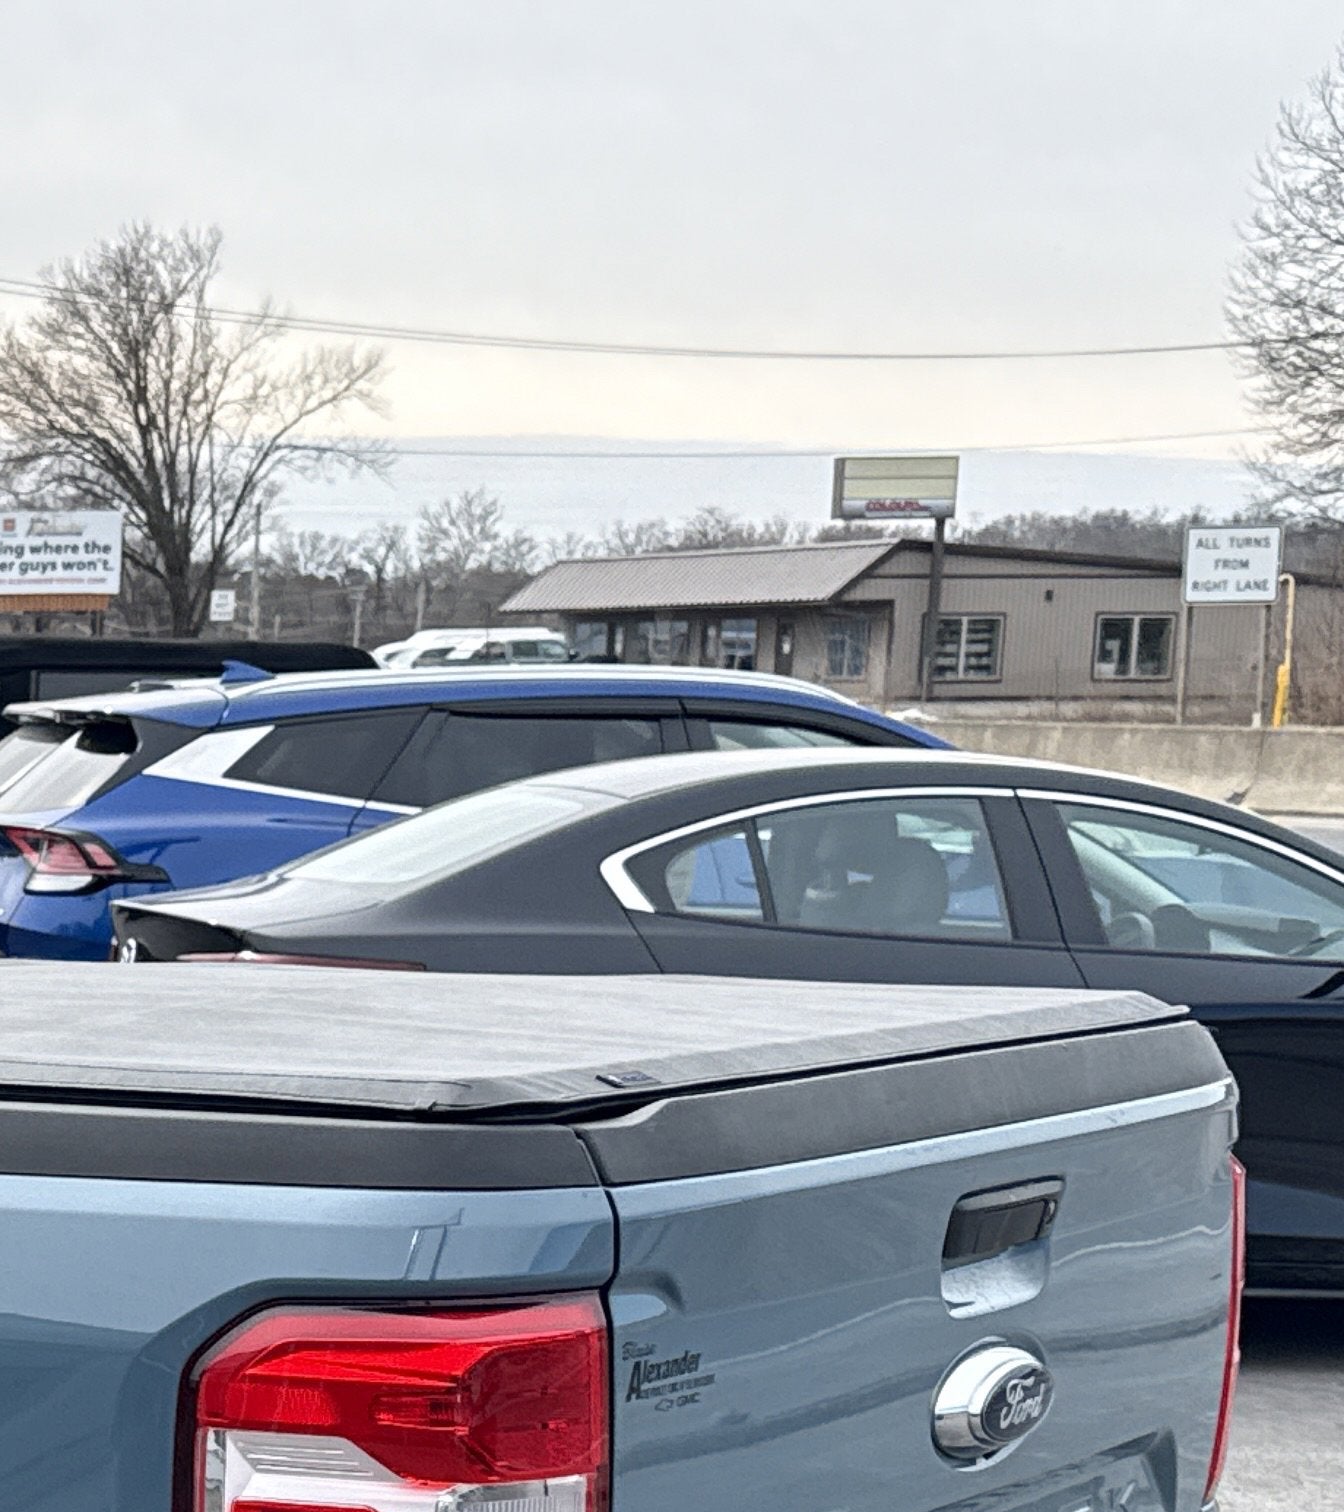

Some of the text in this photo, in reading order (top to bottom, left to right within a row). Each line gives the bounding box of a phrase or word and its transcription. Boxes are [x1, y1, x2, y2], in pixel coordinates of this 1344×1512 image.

[29, 540, 80, 555] where
[83, 540, 112, 554] the
[1195, 536, 1272, 550] ALL TURNS
[18, 560, 58, 576] guys
[62, 558, 114, 572] won't.
[1214, 558, 1250, 570] FROM
[1191, 578, 1270, 592] RIGHT LANE
[625, 1349, 702, 1403] Alexander
[1000, 1375, 1047, 1430] Ford
